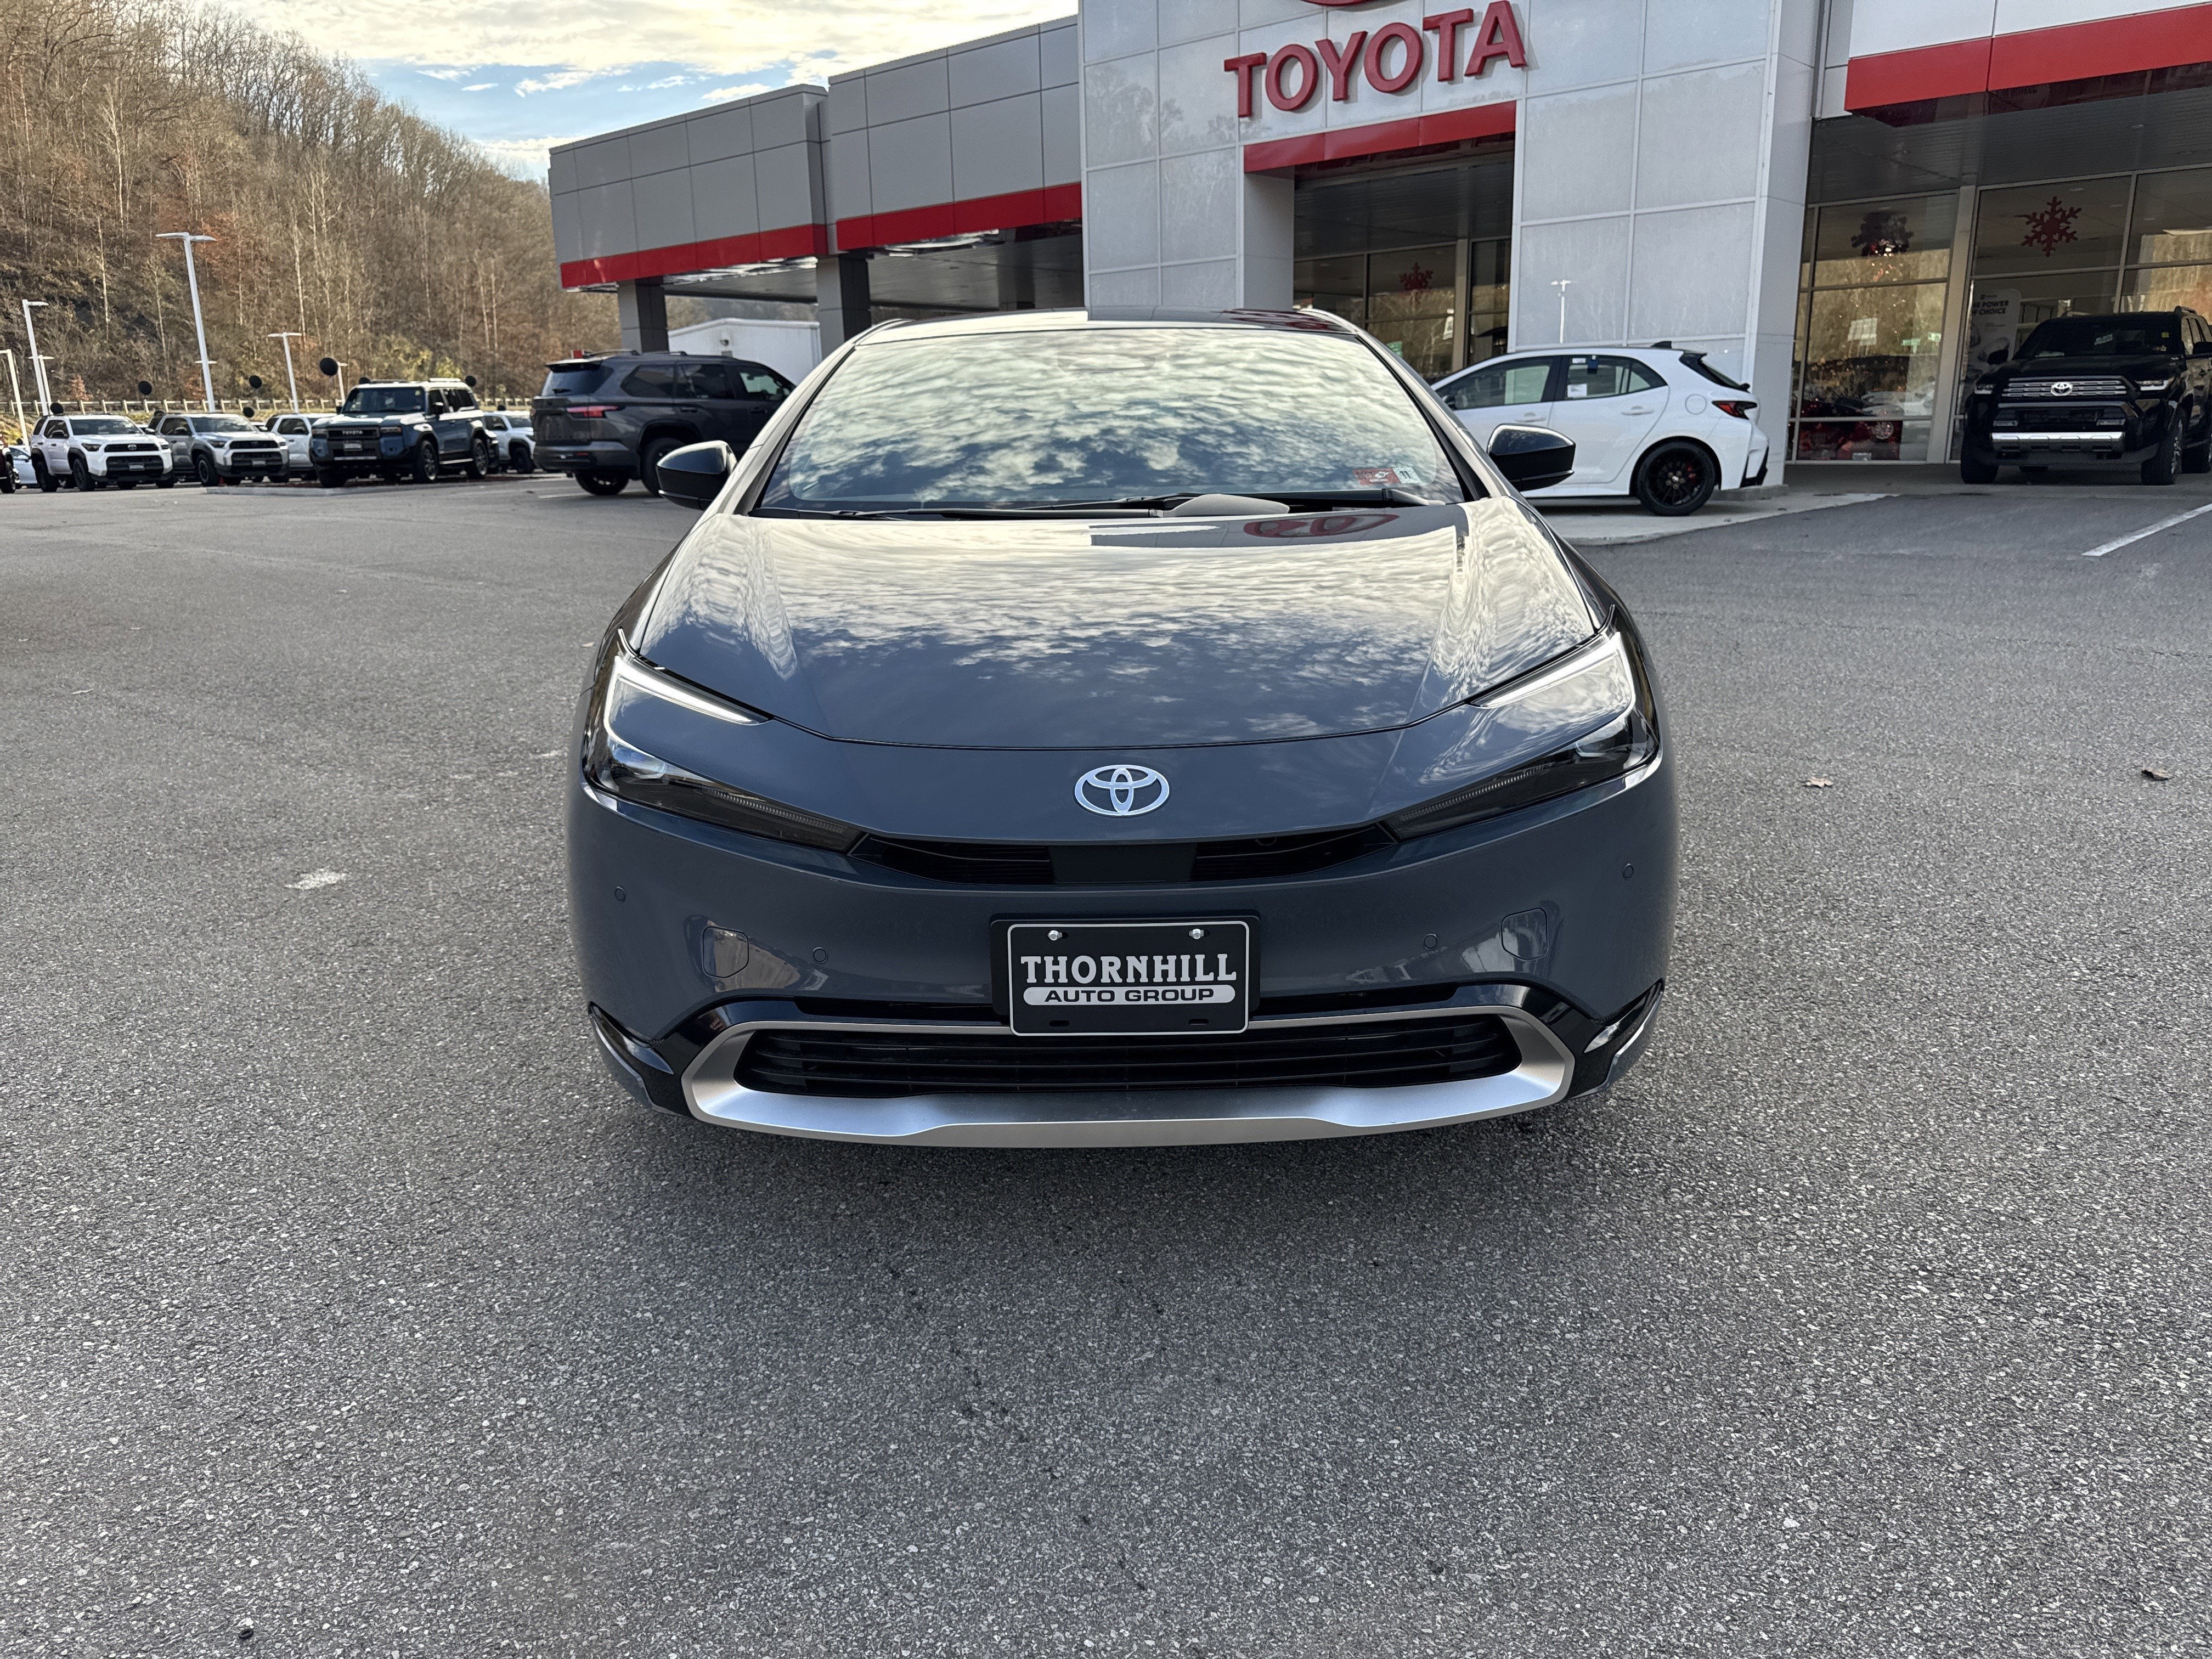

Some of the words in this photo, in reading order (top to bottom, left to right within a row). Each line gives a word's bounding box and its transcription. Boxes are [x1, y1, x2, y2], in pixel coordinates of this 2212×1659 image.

[1224, 1, 1528, 118] TOYOTA
[1020, 953, 1237, 984] THORNHILL
[1045, 990, 1115, 1002] AUTO
[1125, 988, 1214, 1001] GROUP
